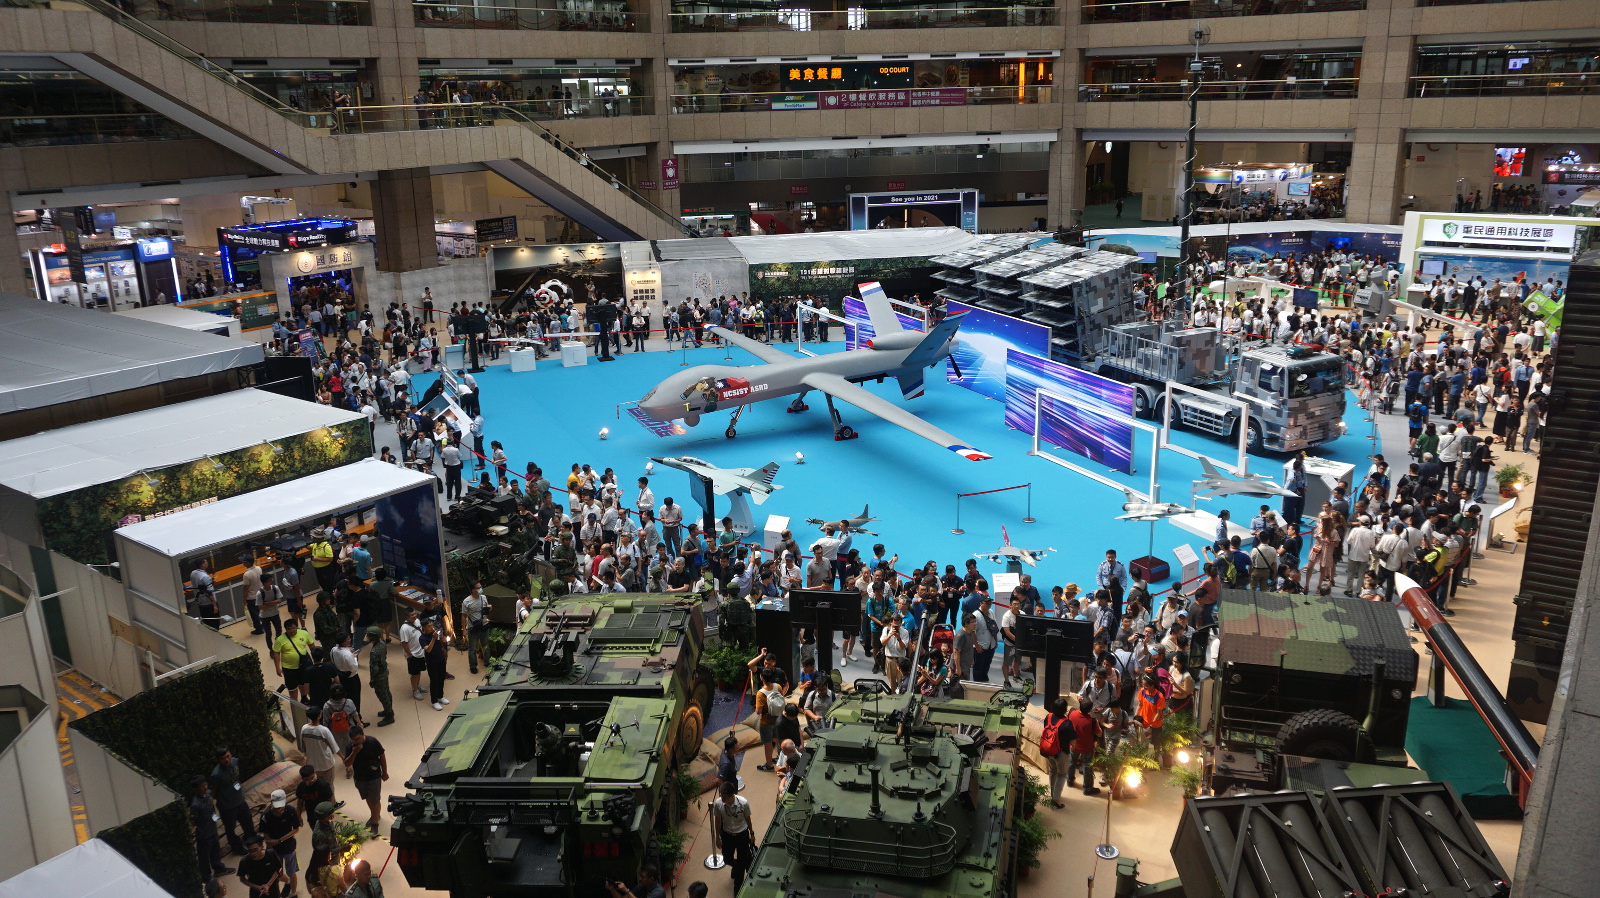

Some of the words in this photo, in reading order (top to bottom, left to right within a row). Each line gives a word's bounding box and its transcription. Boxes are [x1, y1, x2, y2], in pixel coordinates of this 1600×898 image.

[789, 67, 842, 80] 美食餐廳
[841, 92, 906, 101] 2樓餐飲服務區
[1462, 224, 1554, 238] 軍民通用科技展區
[315, 251, 352, 267] 國防館
[723, 387, 749, 398] NCSIST
[750, 383, 769, 393] ASRD
